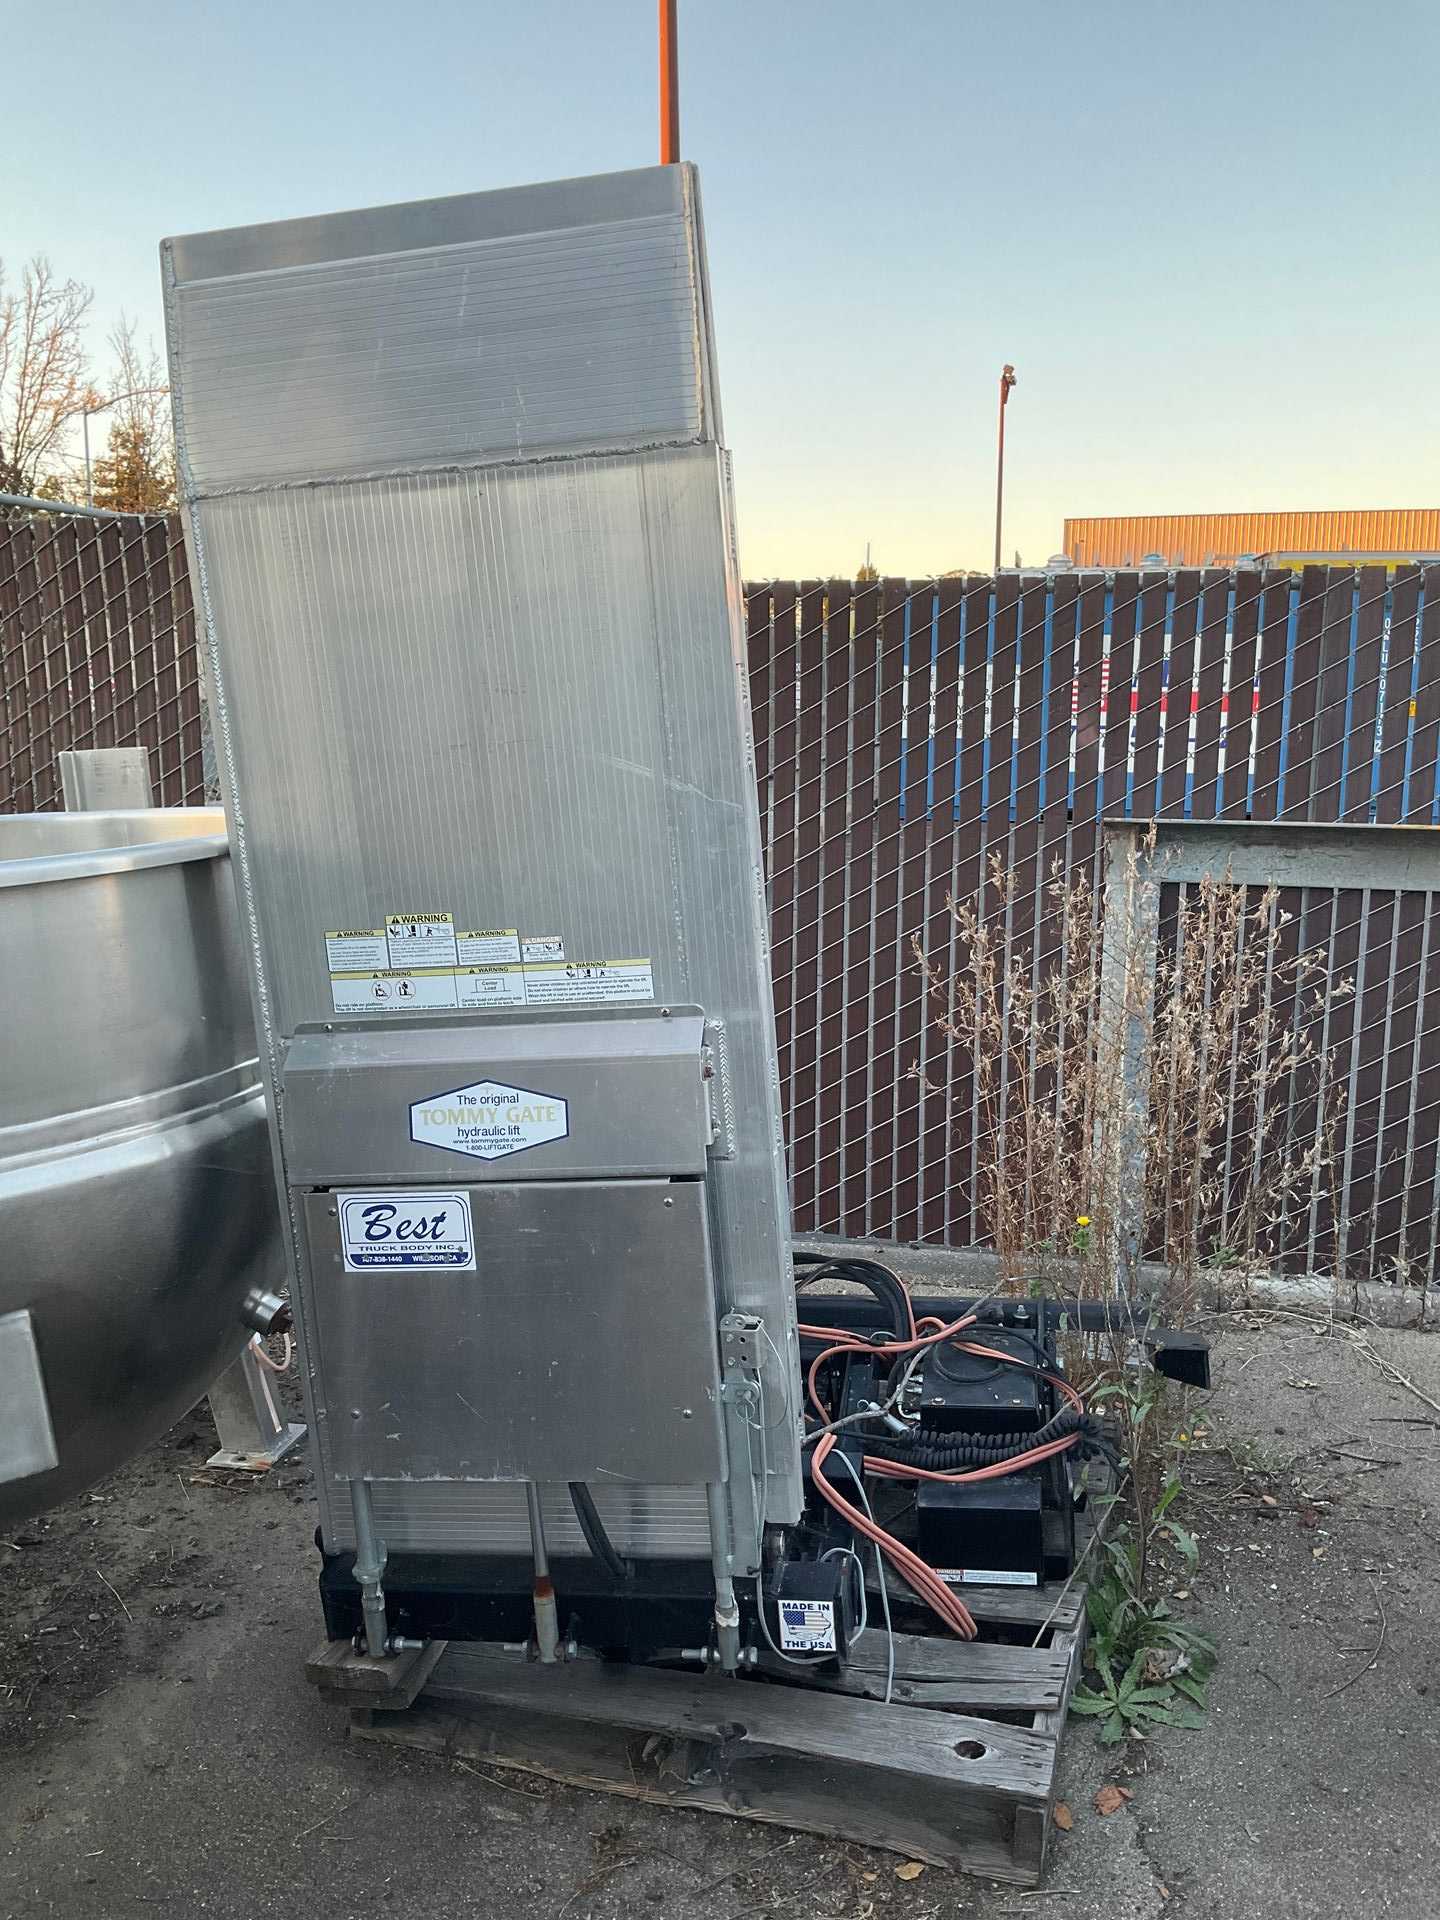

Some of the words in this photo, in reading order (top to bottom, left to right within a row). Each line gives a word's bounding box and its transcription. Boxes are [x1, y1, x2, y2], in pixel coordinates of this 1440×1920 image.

[401, 913, 448, 924] WARNING
[474, 930, 506, 938] WARNING
[530, 936, 560, 944] DANGER
[576, 960, 607, 968] WARNING
[381, 971, 412, 979] WARNING
[457, 1095, 477, 1105] The
[480, 1093, 520, 1107] original
[419, 1107, 498, 1126] TOMMY
[506, 1105, 557, 1123] GATE
[457, 1125, 506, 1139] hydraulic
[508, 1124, 521, 1136] lift
[452, 1137, 527, 1145] www.tommygate.com
[466, 1143, 514, 1151] 1-800-LIFTGATE
[361, 1203, 447, 1242] Best
[782, 1602, 815, 1611] MADE
[818, 1603, 830, 1611] IN
[784, 1640, 807, 1648] THE
[810, 1641, 833, 1649] USA
